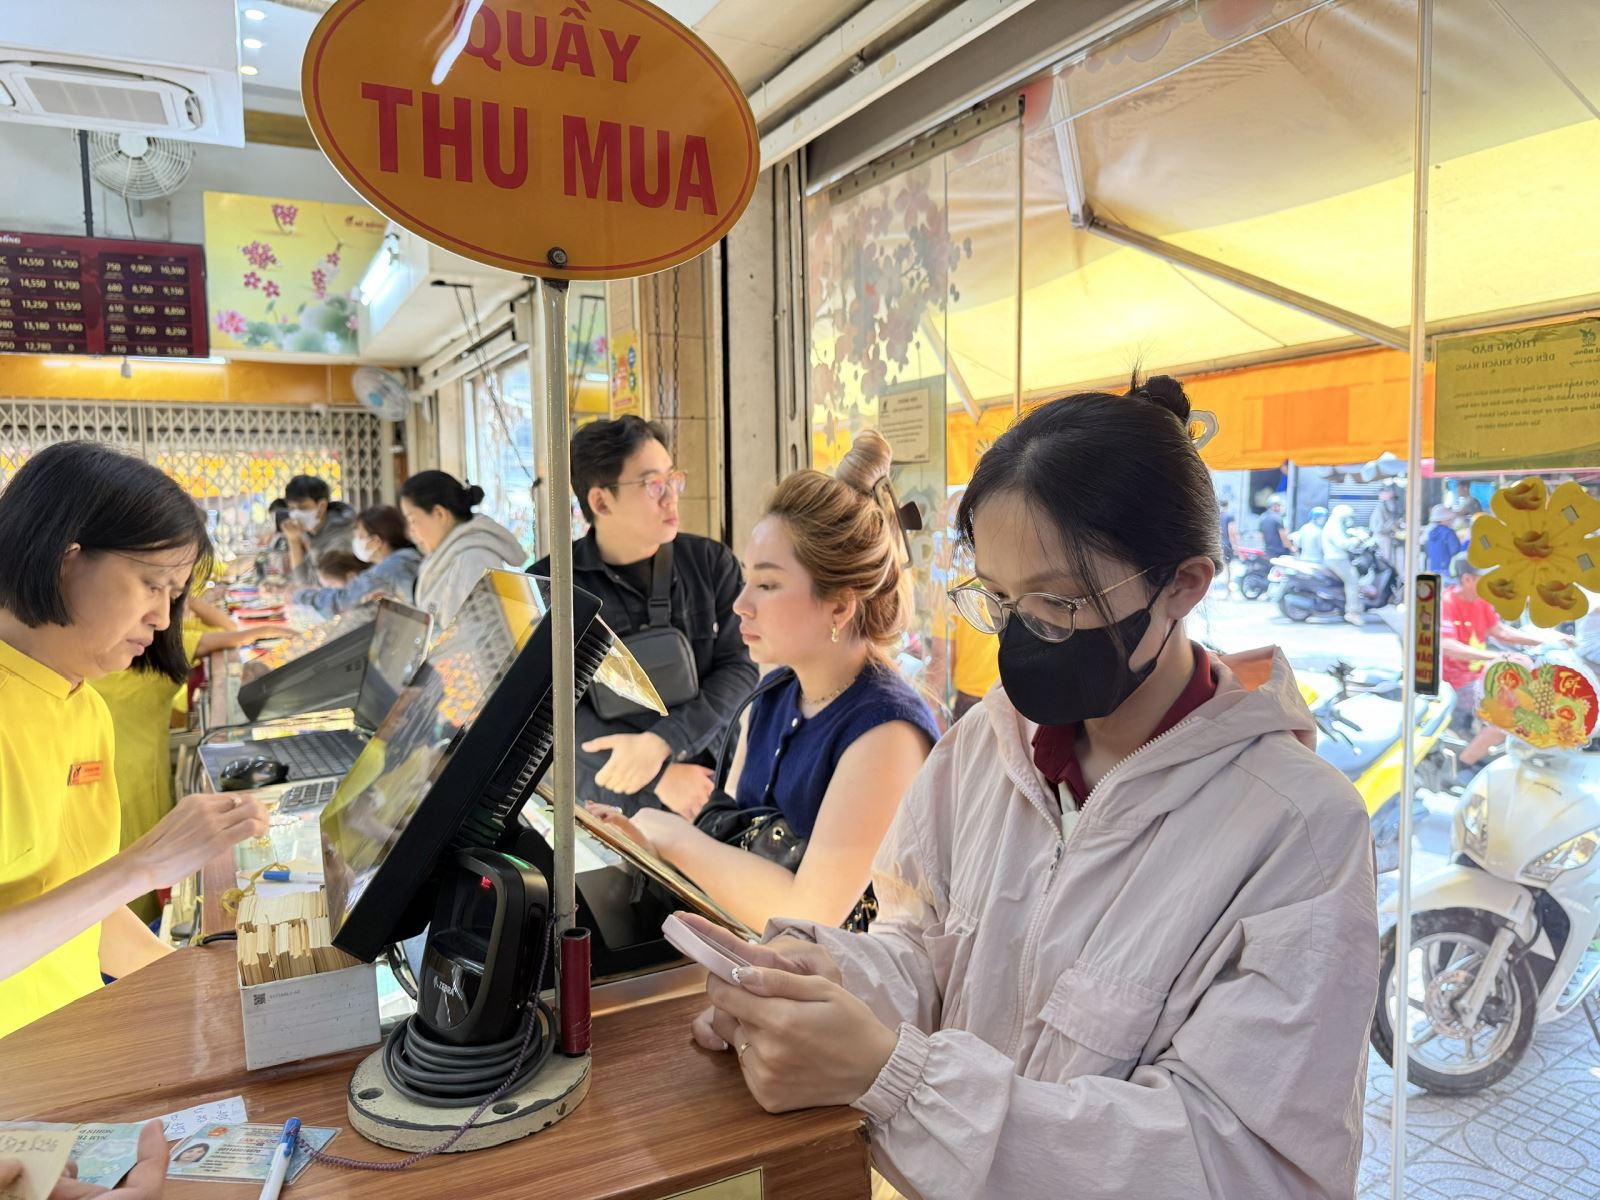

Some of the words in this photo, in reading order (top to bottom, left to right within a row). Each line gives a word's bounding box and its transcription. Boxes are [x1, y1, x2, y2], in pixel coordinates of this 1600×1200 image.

[361, 82, 529, 190] THU
[562, 114, 718, 217] MUA
[18, 256, 45, 267] 14,550
[52, 259, 79, 269] 14,700
[20, 278, 46, 288] 14,550
[54, 280, 80, 290] 14,700
